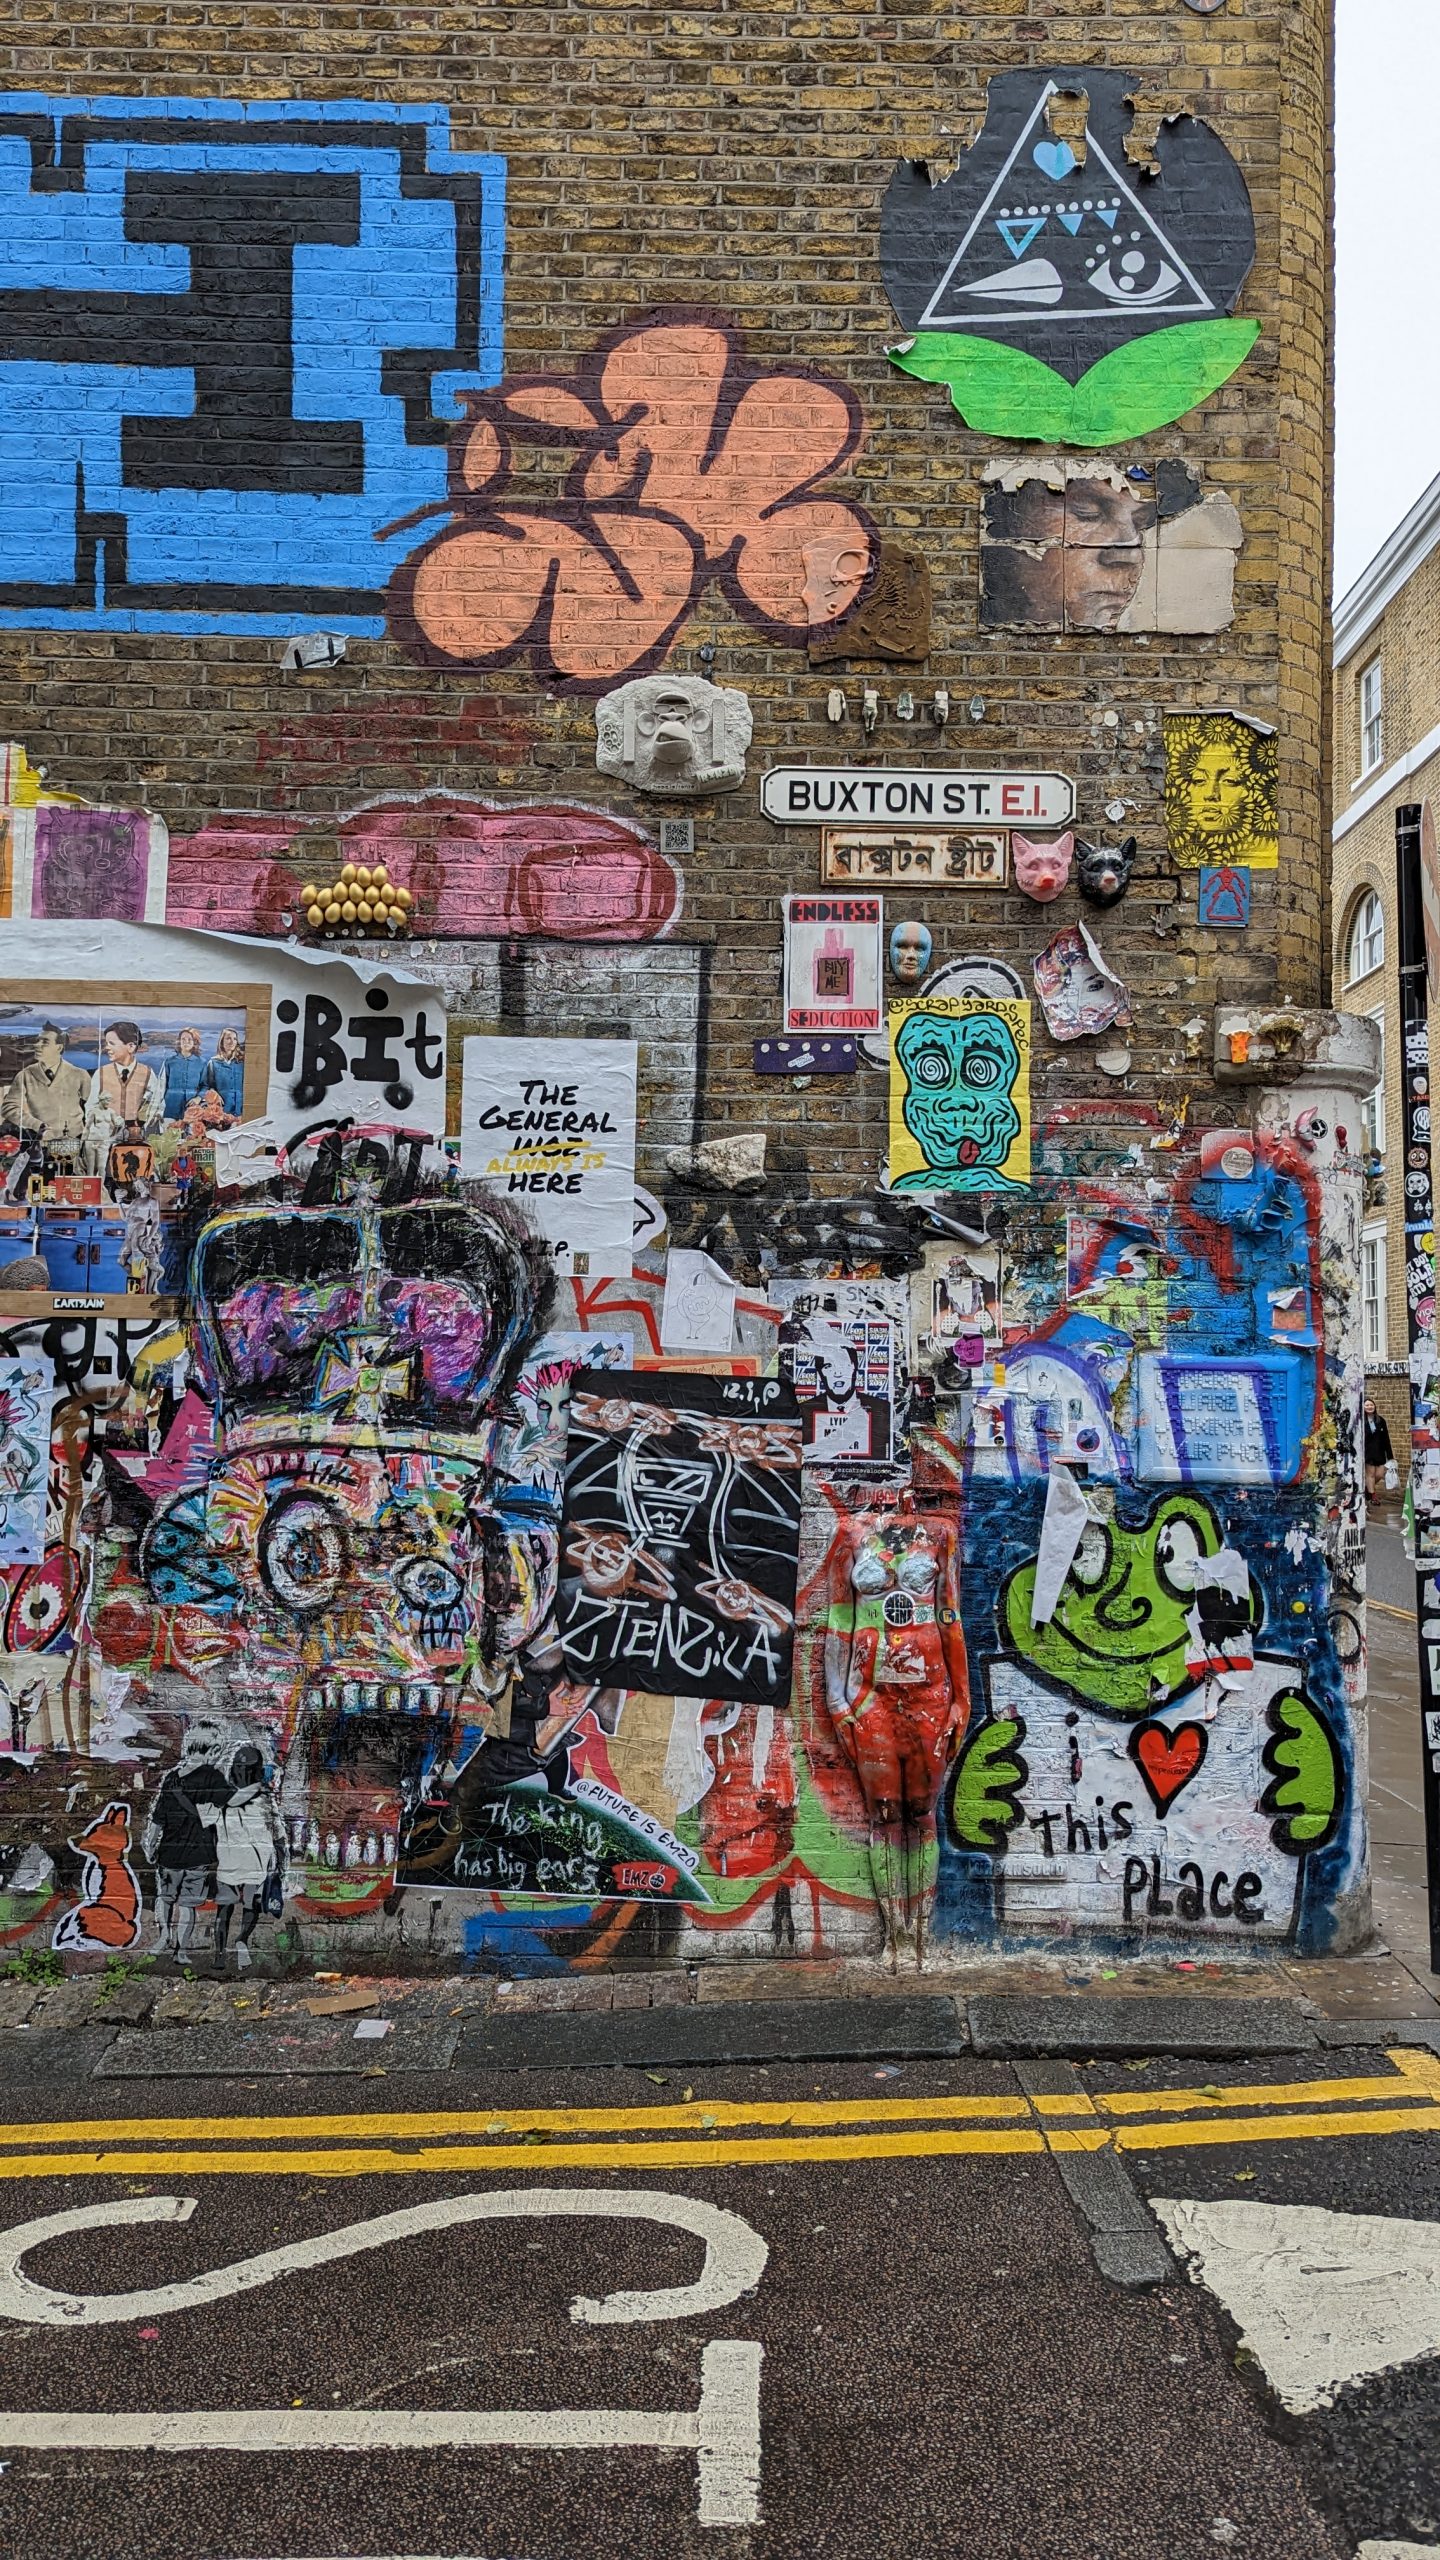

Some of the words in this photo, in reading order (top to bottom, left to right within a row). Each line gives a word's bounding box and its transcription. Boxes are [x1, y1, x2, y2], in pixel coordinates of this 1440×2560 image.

[789, 781, 932, 813] BUXTON
[943, 784, 990, 815] ST.
[792, 902, 877, 921] ENDLESS
[825, 959, 847, 976] BUY
[825, 976, 841, 990] ME
[790, 1010, 876, 1028] SEDUCTION
[519, 1079, 580, 1105] THE
[479, 1105, 617, 1133] GENERAL
[487, 1155, 574, 1173] ALWAYS
[580, 1152, 607, 1171] IS
[508, 1171, 584, 1194] HERE
[53, 1298, 104, 1309] CARTRAIN
[639, 1817, 656, 1836] IS
[1030, 1795, 1133, 1857] this
[453, 1842, 491, 1878] has
